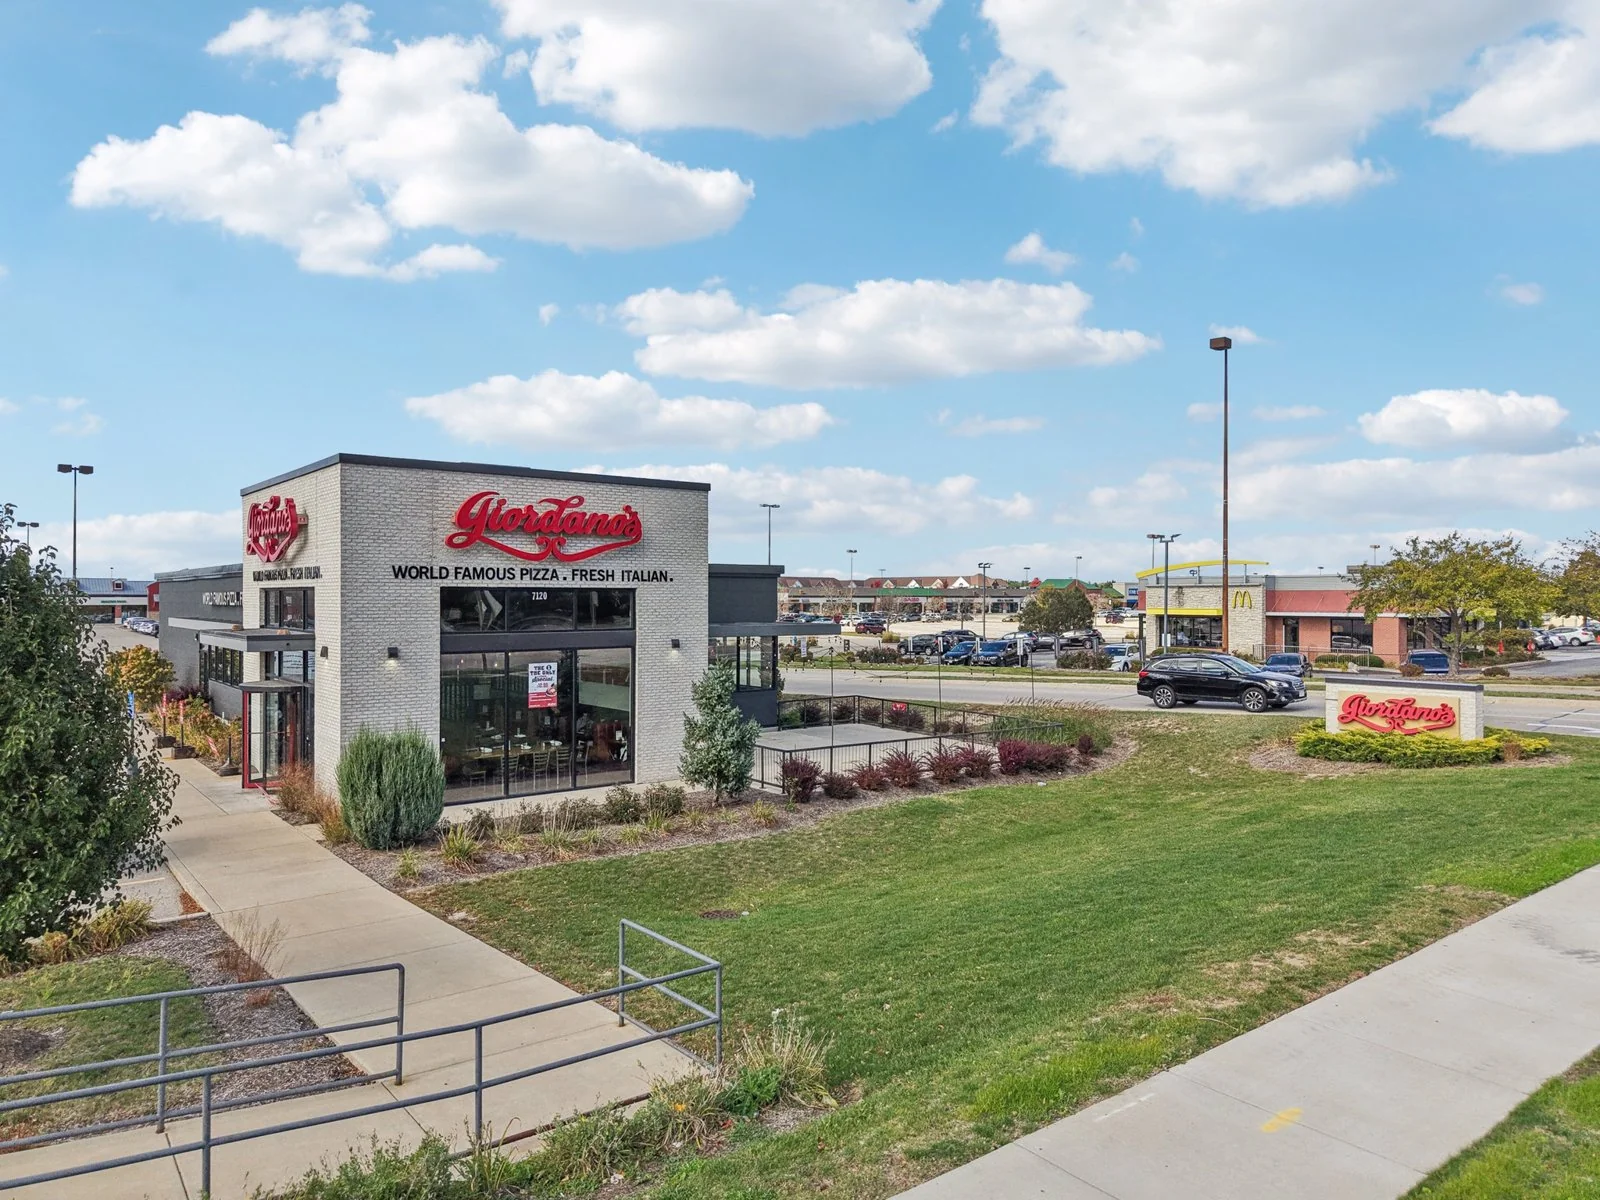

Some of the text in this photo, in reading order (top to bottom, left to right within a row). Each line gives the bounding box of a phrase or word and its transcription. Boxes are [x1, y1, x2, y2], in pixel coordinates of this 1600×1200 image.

[445, 491, 643, 562] Giordano's
[392, 565, 449, 580] WORLD
[454, 566, 516, 580] FAMOUS
[571, 569, 615, 582] FRESH
[531, 591, 548, 600] 7120
[1338, 694, 1456, 735] Giordano's
